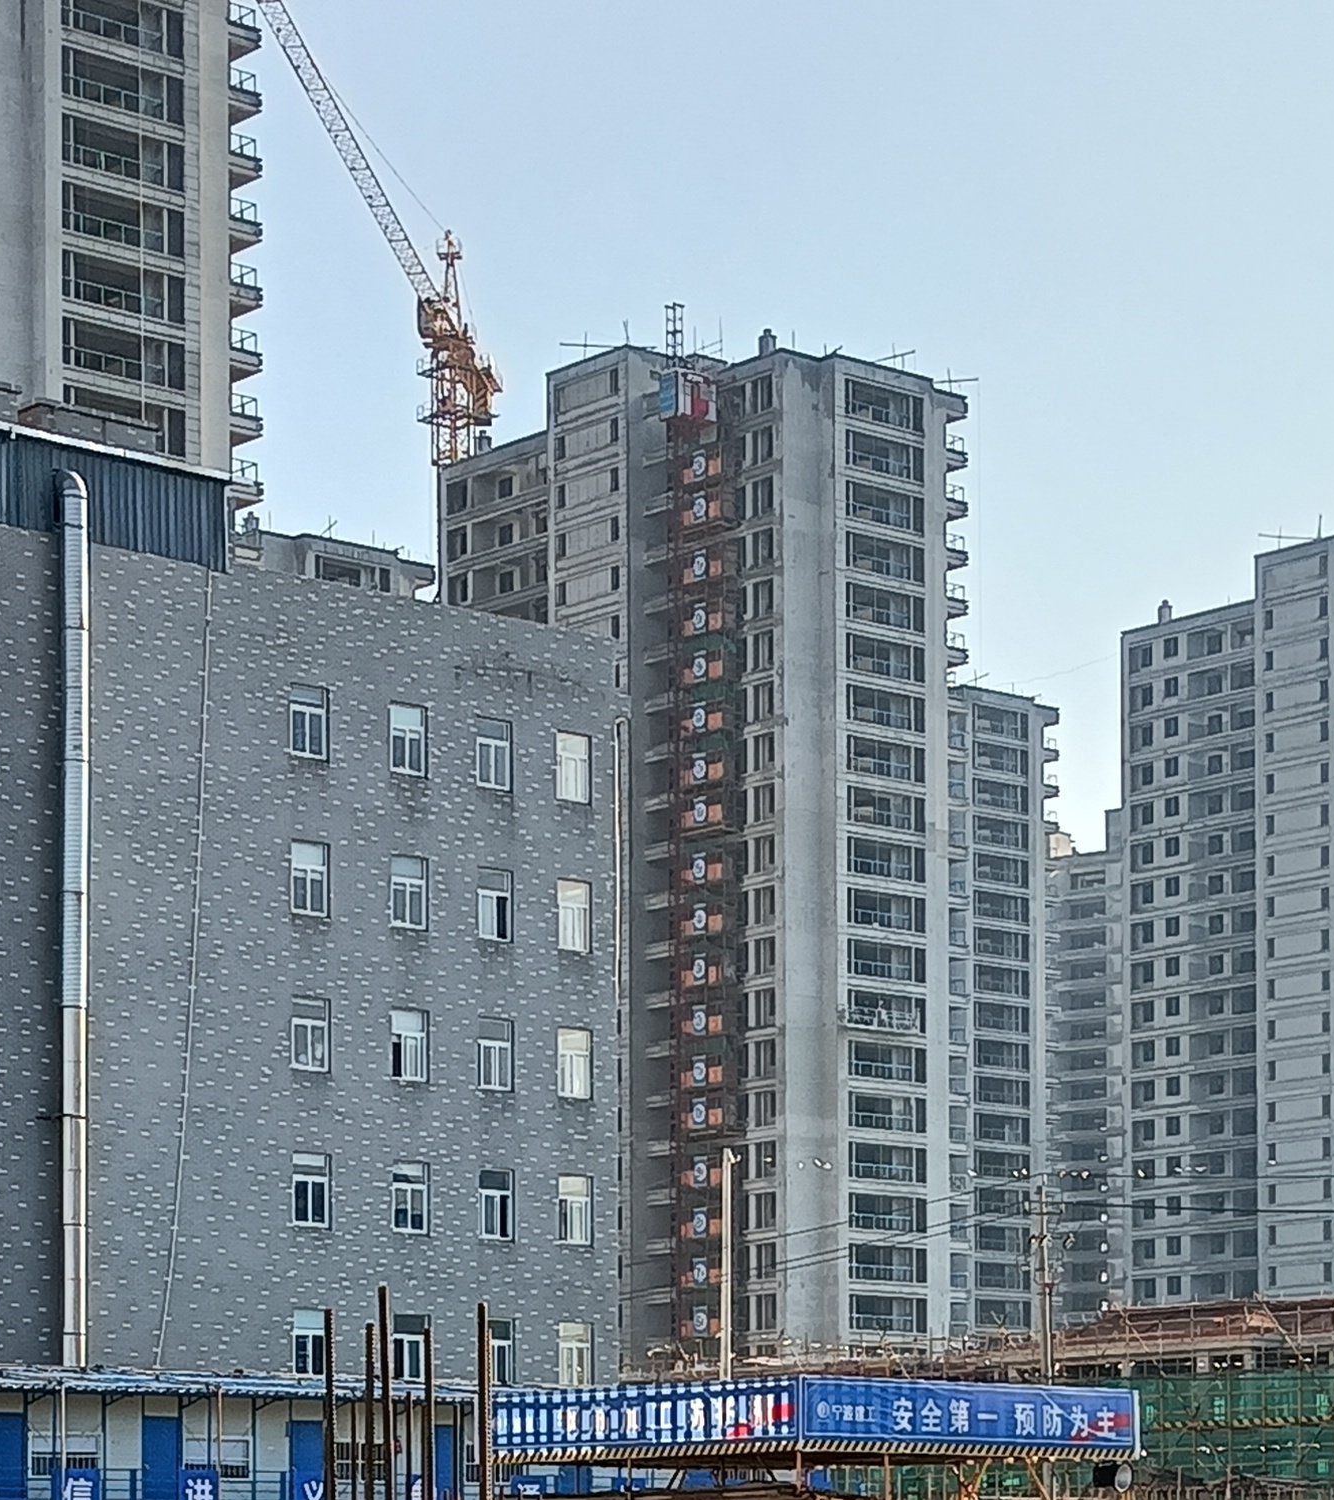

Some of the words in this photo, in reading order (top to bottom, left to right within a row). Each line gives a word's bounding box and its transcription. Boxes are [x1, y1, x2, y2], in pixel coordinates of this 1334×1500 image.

[892, 1397, 999, 1433] 安全第一
[1014, 1403, 1117, 1438] 预防为主
